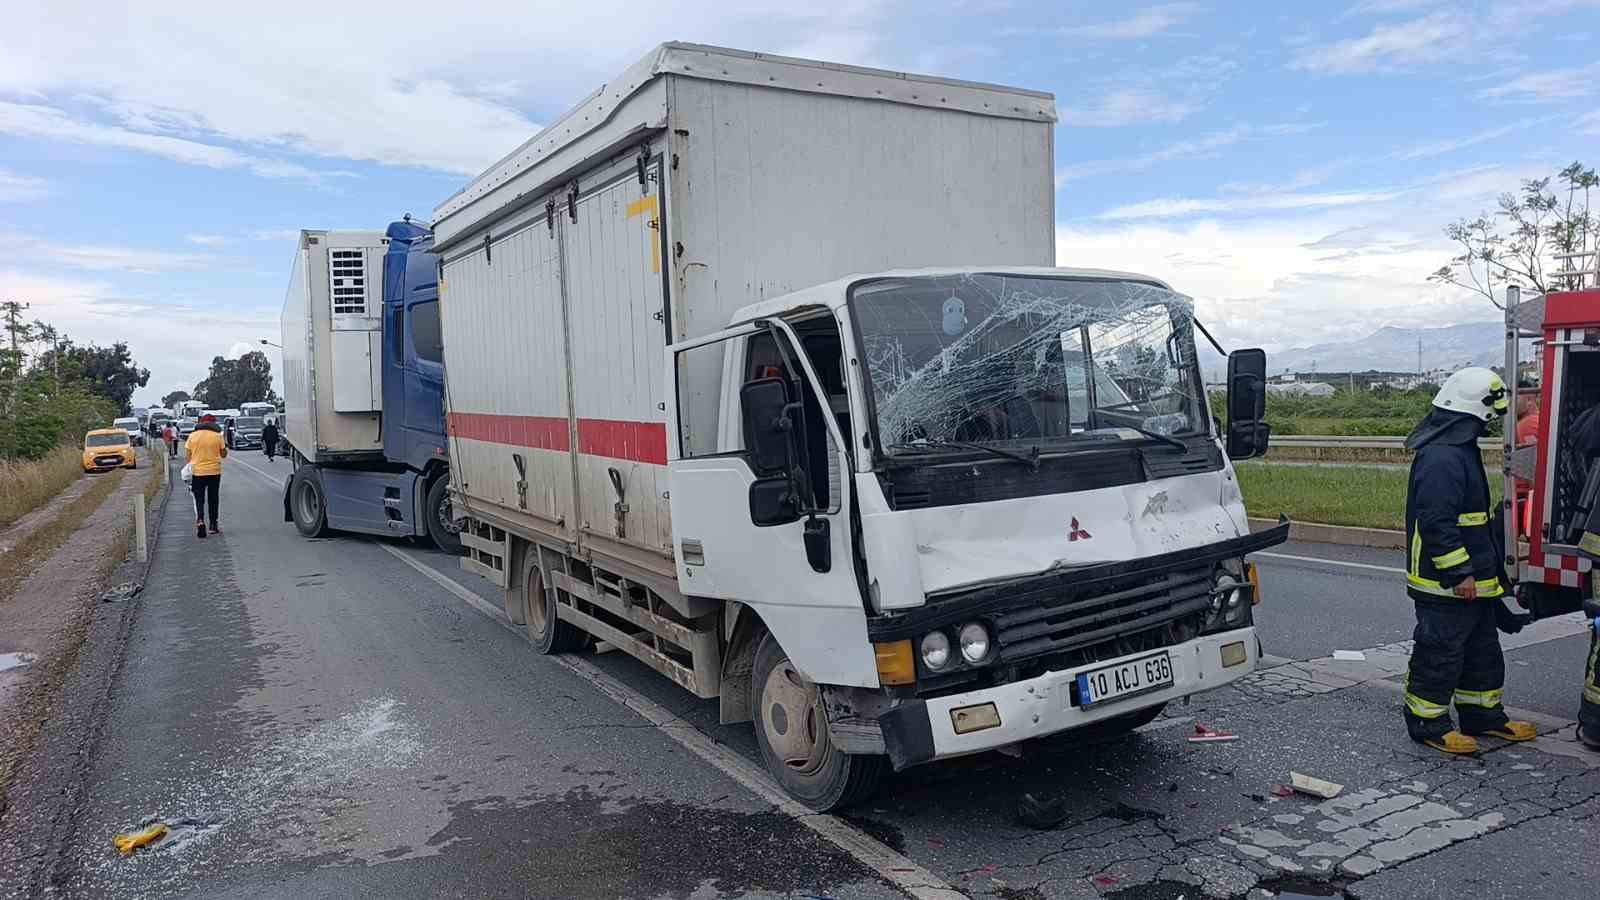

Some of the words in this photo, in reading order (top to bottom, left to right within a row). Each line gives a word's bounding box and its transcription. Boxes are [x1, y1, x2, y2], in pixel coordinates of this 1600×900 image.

[1090, 673, 1108, 698] 10
[1114, 665, 1139, 692] ACJ
[1145, 658, 1169, 683] 636
